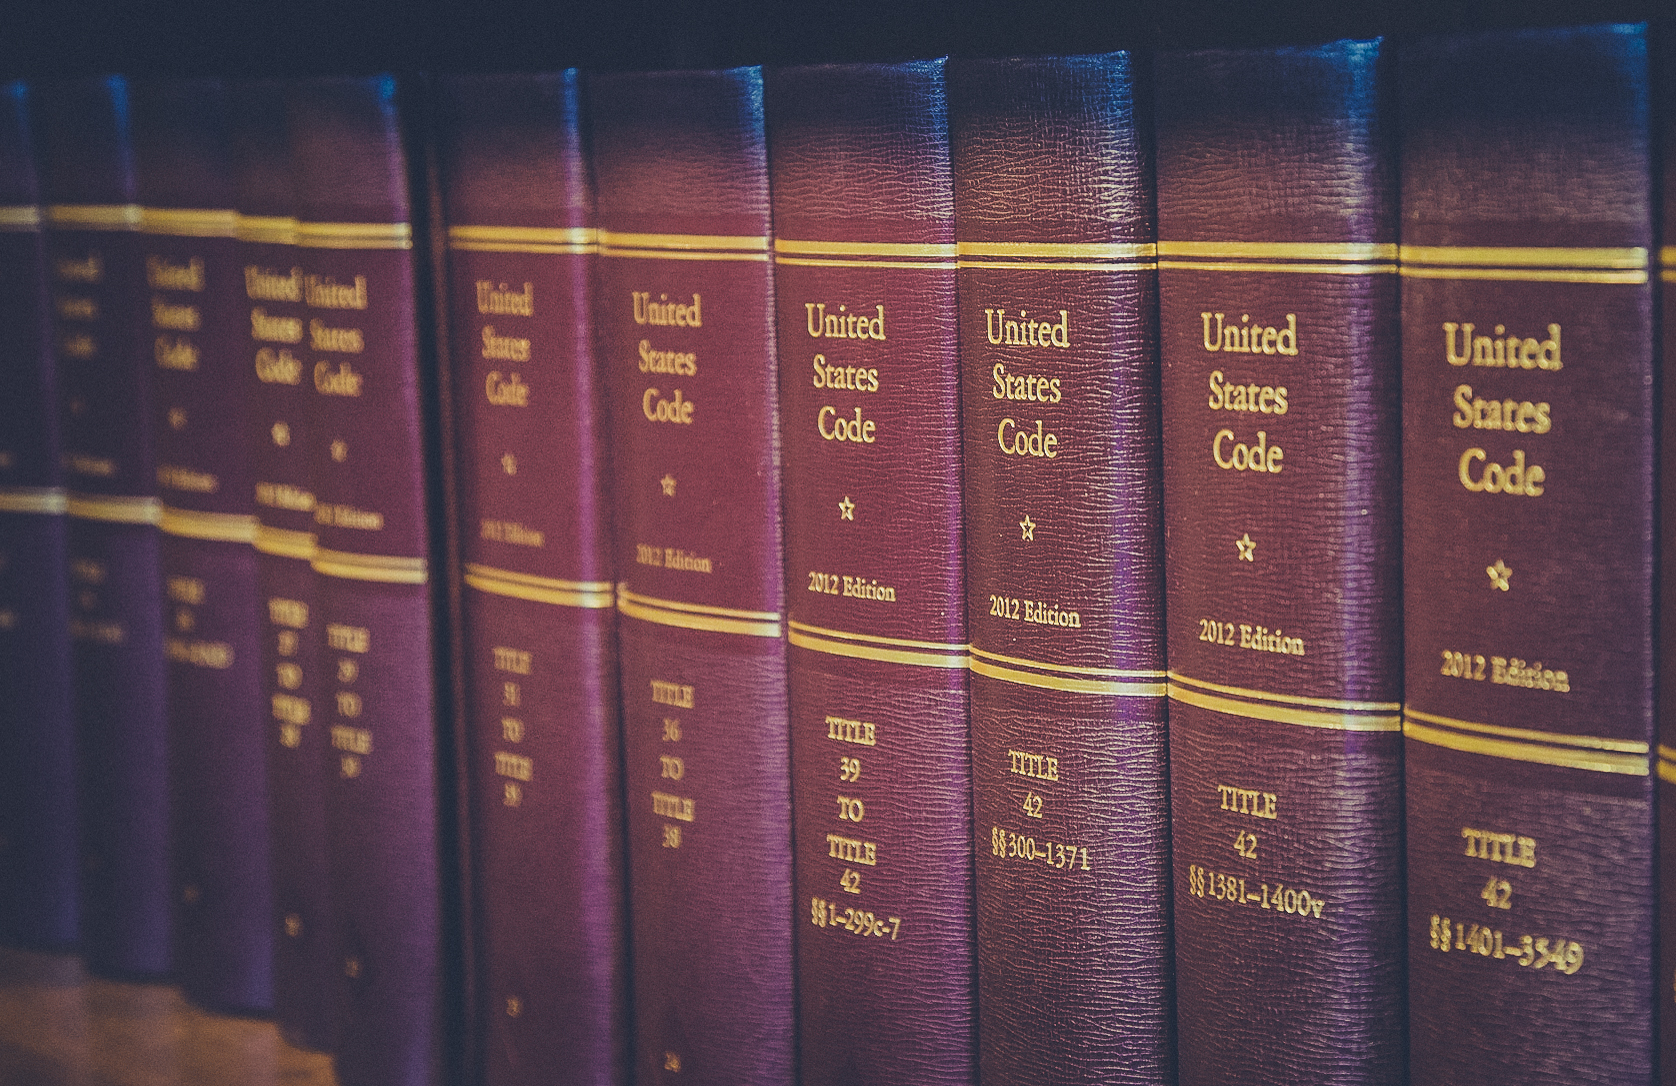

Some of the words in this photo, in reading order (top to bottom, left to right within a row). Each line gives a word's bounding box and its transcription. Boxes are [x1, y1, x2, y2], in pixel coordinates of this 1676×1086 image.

[633, 292, 701, 327] United
[805, 303, 886, 340] United
[985, 309, 1070, 348] United
[1201, 312, 1298, 355] United
[1444, 322, 1562, 370] United
[639, 340, 696, 376] States
[813, 354, 879, 392] States
[993, 363, 1061, 403] States
[1209, 371, 1287, 414] States
[643, 388, 693, 424] Code
[1454, 385, 1551, 433] States
[818, 406, 875, 443] Code
[998, 418, 1057, 458] Code
[1213, 430, 1283, 473] Code
[1460, 448, 1544, 496] Code
[808, 572, 838, 594] 2012
[843, 576, 896, 601] Edition
[990, 595, 1019, 619] 2012
[1024, 600, 1081, 628] Edition
[1199, 619, 1234, 645] 2012
[1240, 625, 1305, 655] Edition
[1442, 651, 1485, 680] 2012
[1492, 657, 1570, 692] Edition
[826, 716, 876, 746] TITLE
[839, 757, 861, 783] 39
[1008, 750, 1059, 781] TITLE
[837, 796, 864, 822] TO
[1023, 792, 1042, 818] 42
[1218, 785, 1277, 819] TITLE
[827, 835, 876, 865] TITLE
[1234, 830, 1257, 859] 42
[1463, 828, 1536, 868] TITLE
[840, 869, 860, 894] 42
[1482, 879, 1512, 909] 42
